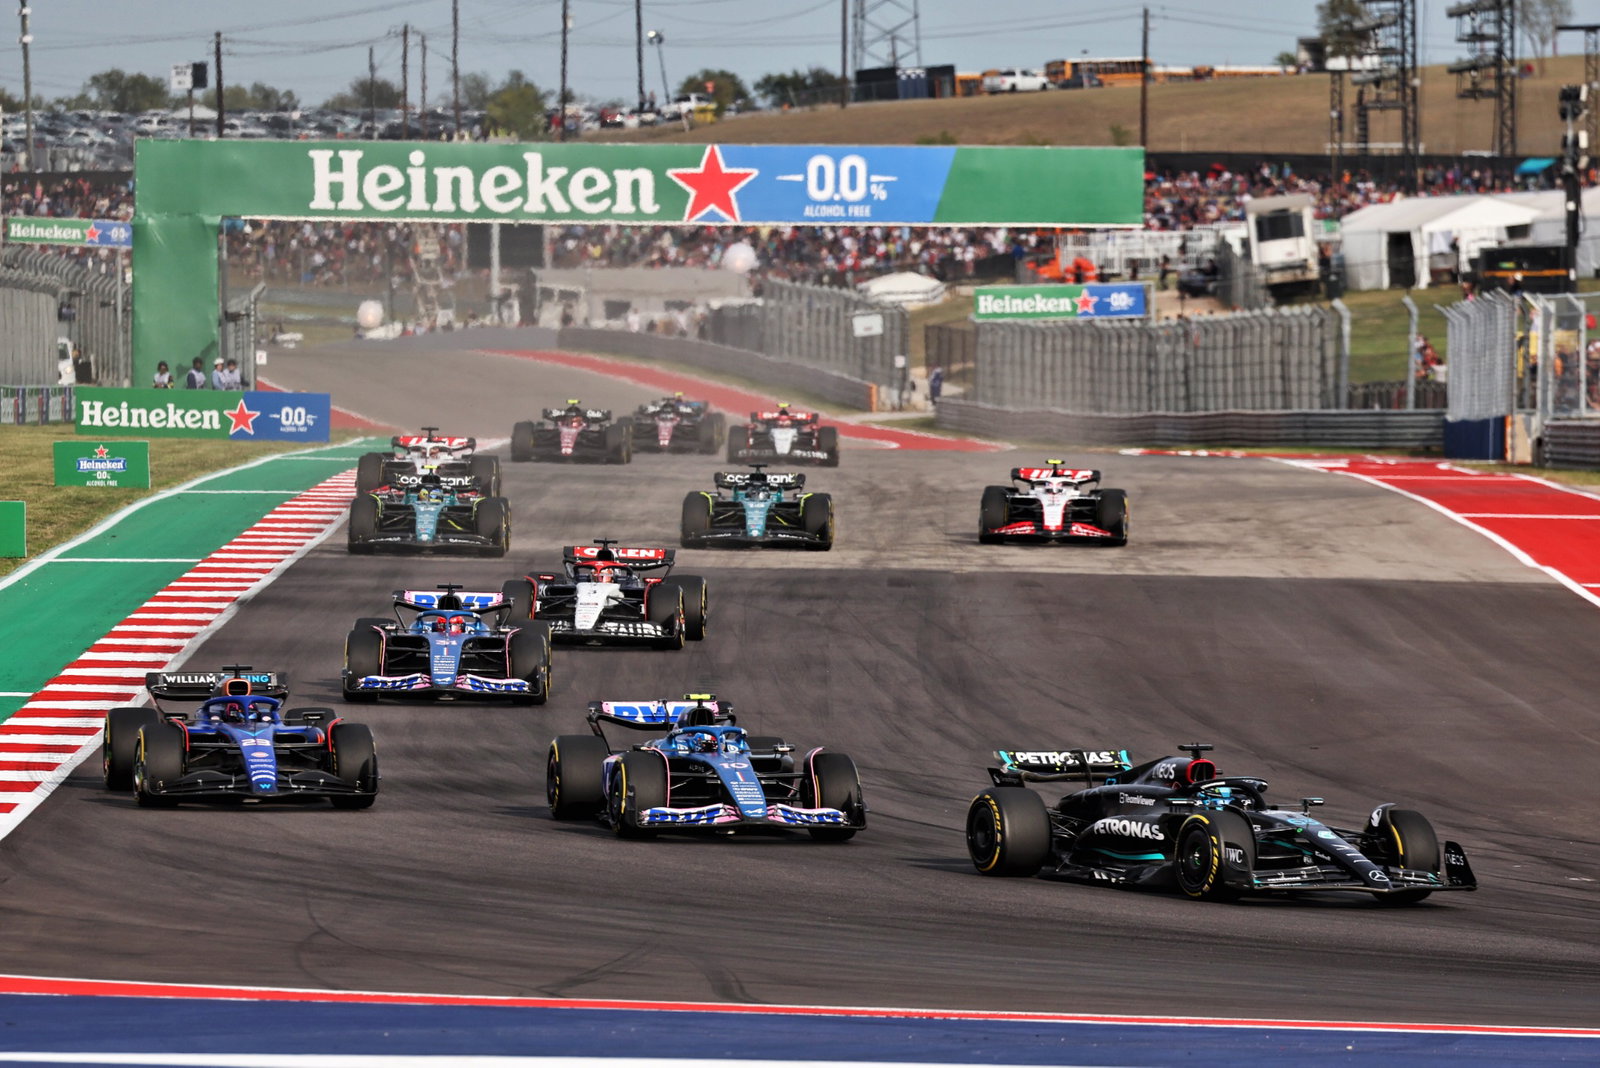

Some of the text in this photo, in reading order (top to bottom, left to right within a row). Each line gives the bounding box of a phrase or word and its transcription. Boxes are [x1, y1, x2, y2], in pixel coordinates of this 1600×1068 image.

[308, 150, 660, 214] Heineken
[804, 205, 871, 217] ALCOHOL FREE
[10, 223, 82, 240] Heineken
[978, 294, 1072, 313] Heineken
[80, 401, 221, 429] Heineken
[80, 460, 123, 469] Heineken
[400, 476, 470, 486] cozant
[583, 547, 656, 558] OLEN
[165, 674, 218, 684] WILLIAM
[241, 738, 271, 747] 23
[1015, 750, 1114, 765] PETROAS
[1152, 763, 1177, 779] INEOS
[1125, 793, 1156, 806] TeamViewer
[1093, 818, 1165, 840] PETRONAS
